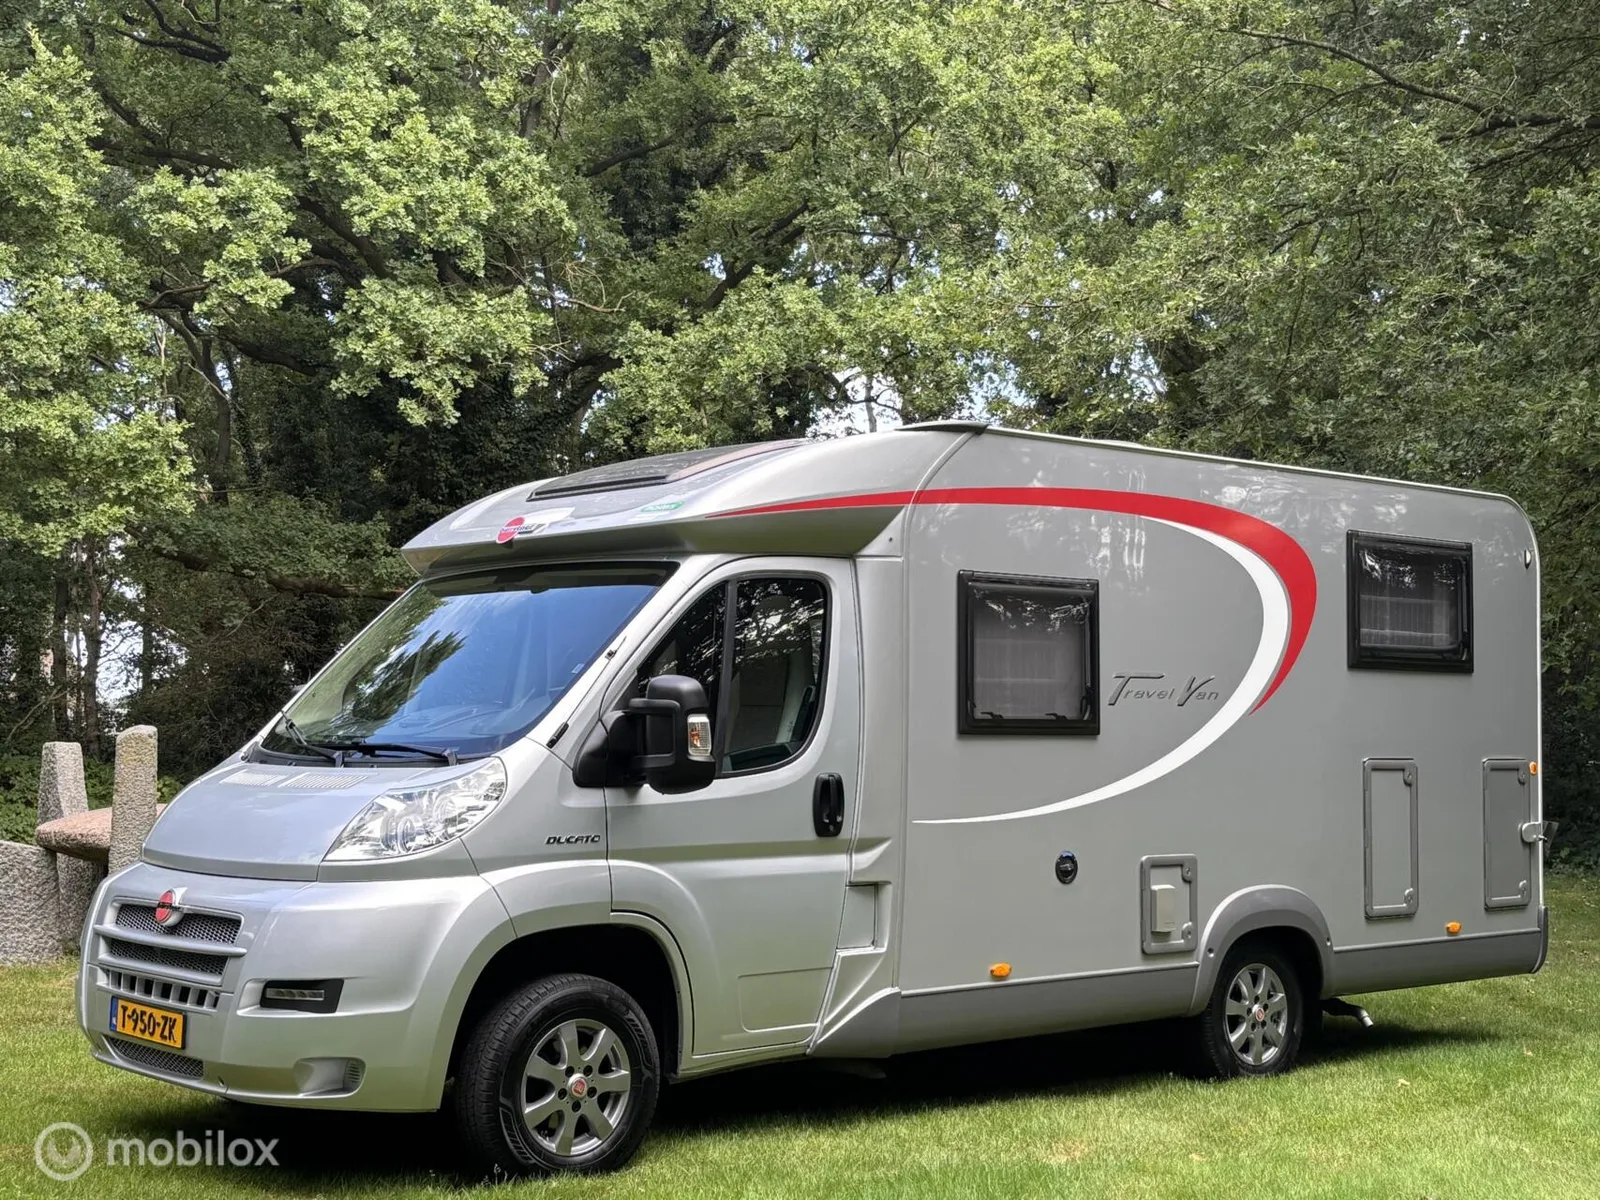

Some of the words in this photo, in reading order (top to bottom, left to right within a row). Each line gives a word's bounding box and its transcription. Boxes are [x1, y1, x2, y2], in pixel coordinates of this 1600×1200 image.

[1107, 673, 1175, 706] Travel
[1177, 675, 1219, 707] Van
[545, 834, 601, 845] DUCATO
[120, 1004, 177, 1043] T-950-ZK
